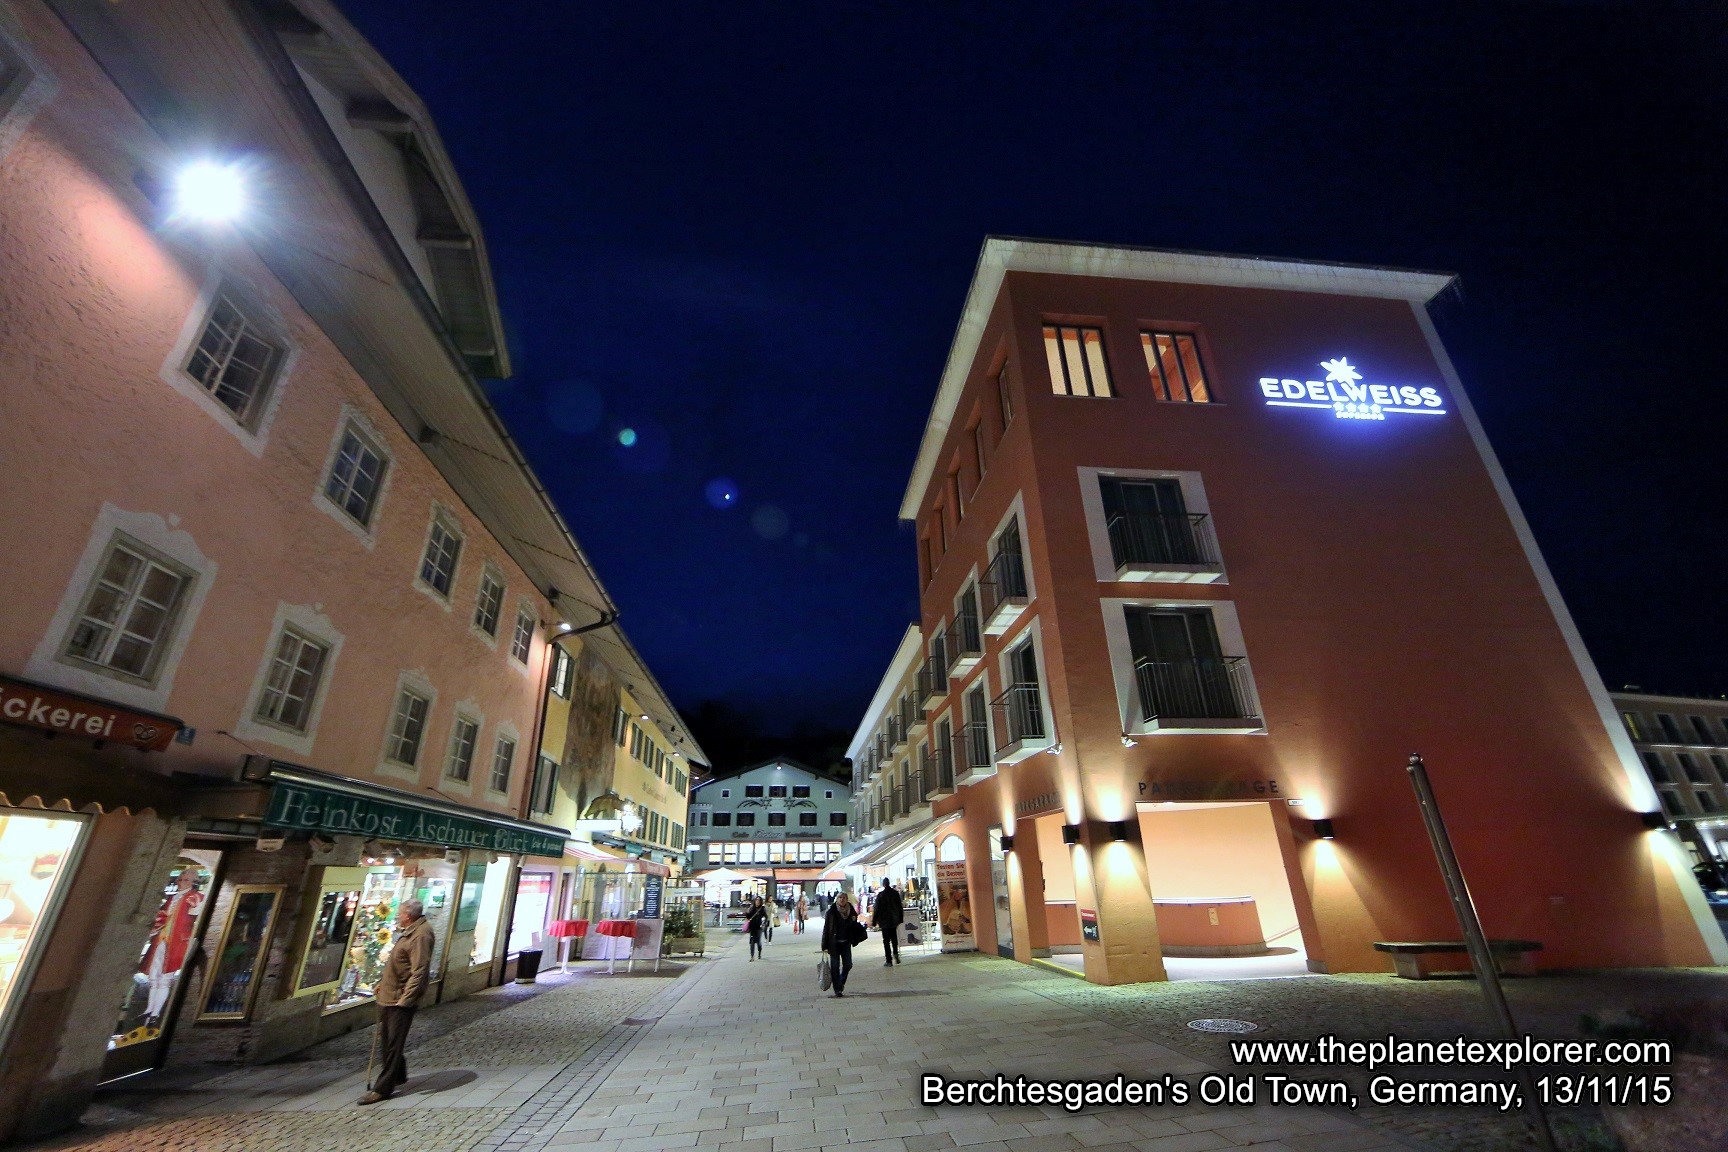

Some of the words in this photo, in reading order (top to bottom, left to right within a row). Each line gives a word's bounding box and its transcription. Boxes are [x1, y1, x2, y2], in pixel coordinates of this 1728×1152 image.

[1259, 377, 1442, 407] EDELWEISS
[0, 687, 116, 737] ckerei
[277, 788, 402, 836] Feinkost
[406, 813, 489, 847] Aschauer
